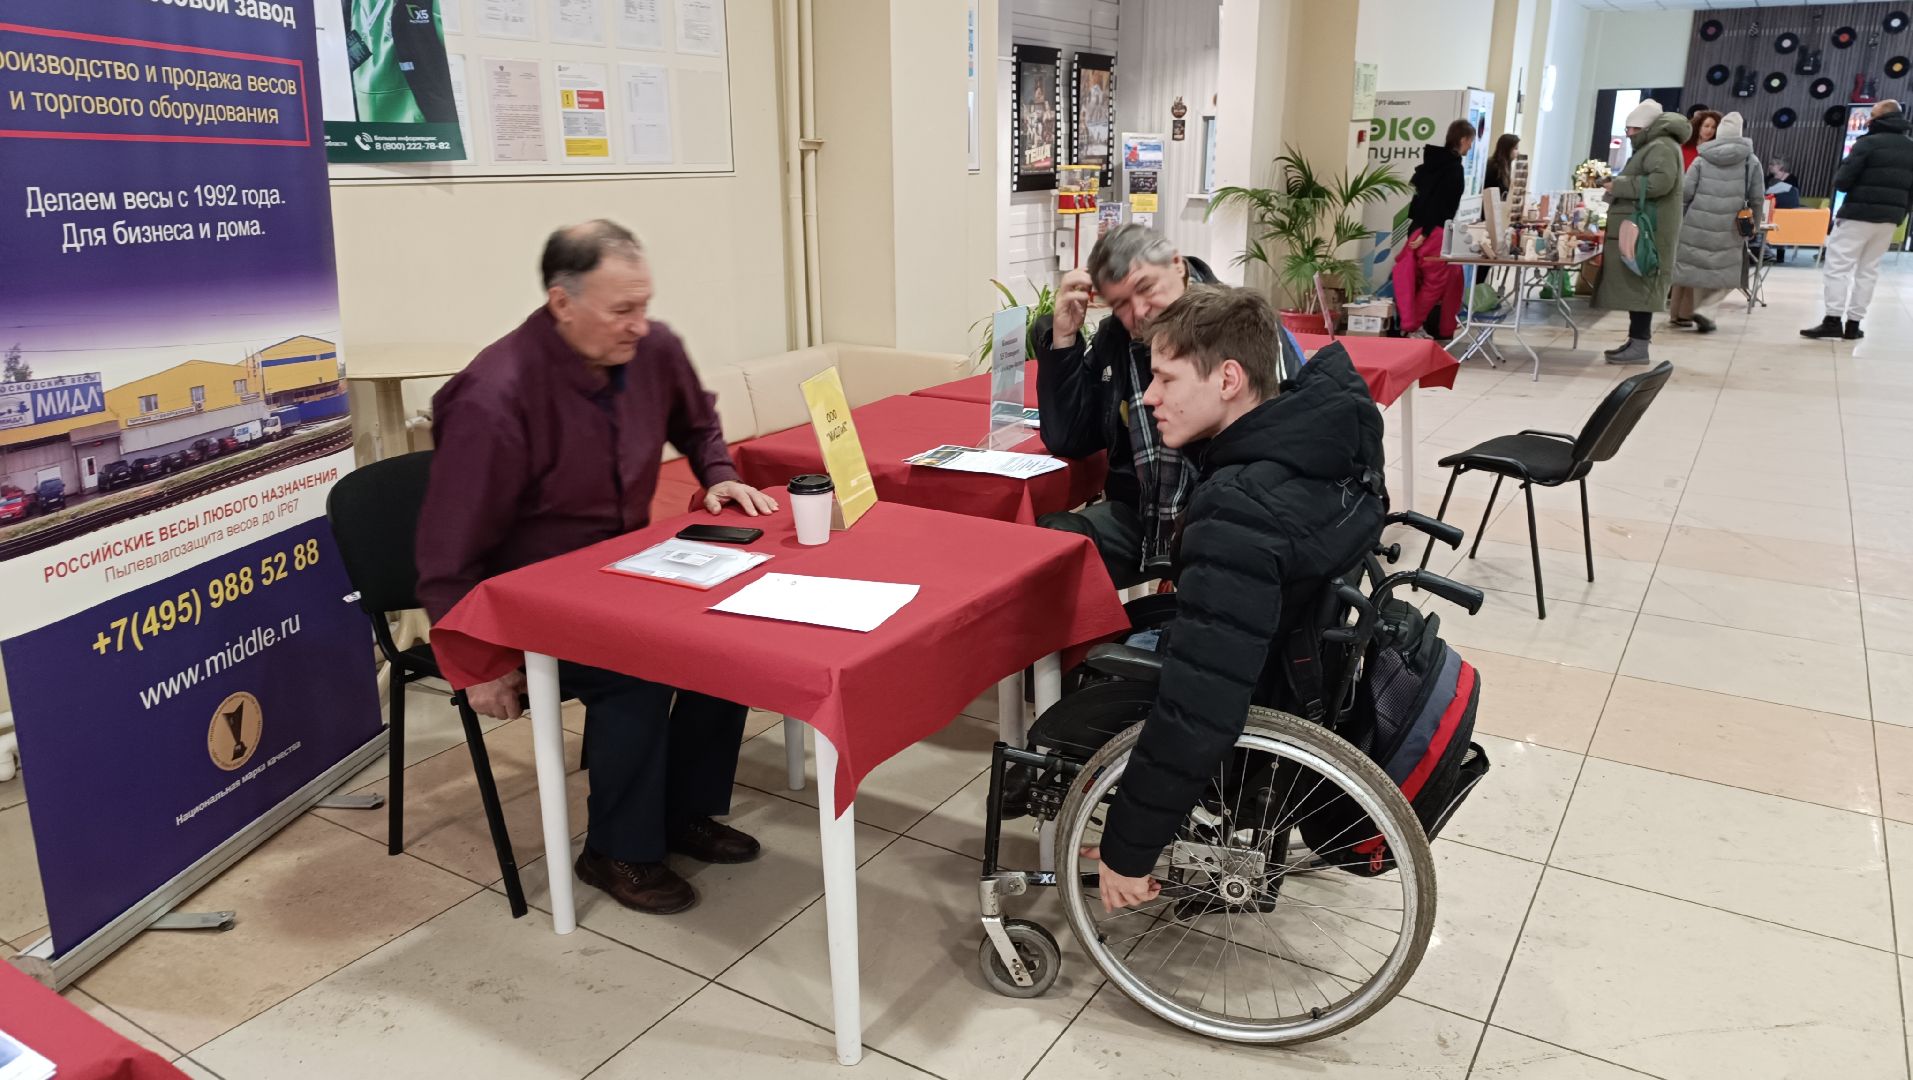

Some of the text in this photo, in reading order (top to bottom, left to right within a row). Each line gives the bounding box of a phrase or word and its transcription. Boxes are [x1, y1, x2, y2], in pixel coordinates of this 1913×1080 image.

[234, 0, 297, 29] завод
[0, 50, 297, 95] оизводство и продажа весов
[9, 90, 279, 125] и торгового оборудования
[375, 142, 382, 150] 8
[382, 142, 406, 151] (800)
[1368, 146, 1426, 164] пунк
[26, 184, 286, 218] Делаем весы с 1992 года.
[62, 219, 266, 253] Для бизнеса и дома.
[0, 378, 66, 393] ОСКОВСКИЕ
[36, 386, 102, 418] МИДЛ
[44, 467, 337, 583] РОССИЙСКИЕ ВЕСЫ ЛЮБОГО НАЗНАЧЕНИЯ
[104, 498, 299, 583] Пылевлагозащита весов до IP67
[91, 538, 320, 656] +7(495) 988 52 88
[139, 612, 301, 710] www.middle.ru
[176, 741, 302, 826] Национальная марка качества
